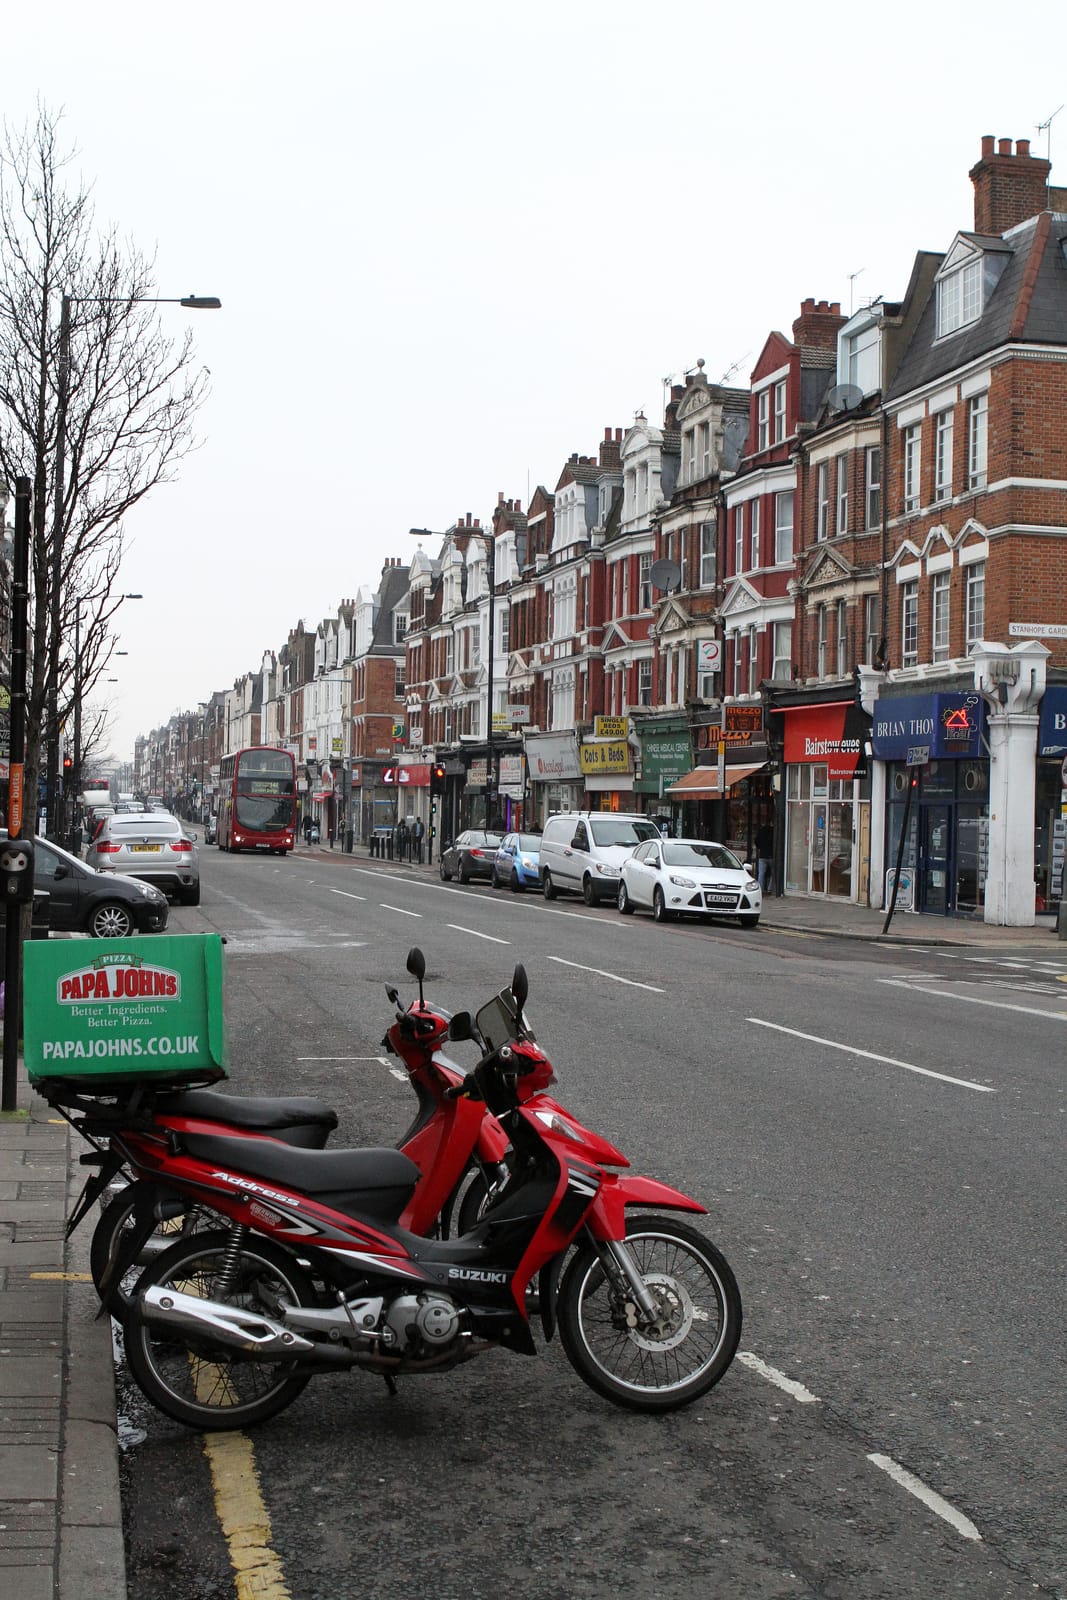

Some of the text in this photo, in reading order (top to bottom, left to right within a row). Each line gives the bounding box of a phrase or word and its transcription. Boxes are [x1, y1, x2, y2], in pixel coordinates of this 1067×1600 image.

[1012, 625, 1045, 634] STANHOPE
[726, 707, 760, 715] mezzo
[877, 720, 905, 737] BRIAN
[584, 746, 624, 763] Cots & Beds
[805, 737, 860, 756] Bairstow eves
[11, 772, 20, 826] gum butts
[102, 954, 132, 964] PIZZA
[61, 971, 110, 1000] PAPA
[71, 1003, 168, 1017] Better Ingredients.
[88, 1015, 153, 1028] Better Pizza.
[42, 1035, 200, 1060] PAPAJOHNS.CO.UK
[211, 1171, 301, 1208] Address
[448, 1267, 507, 1284] SUZUKI
